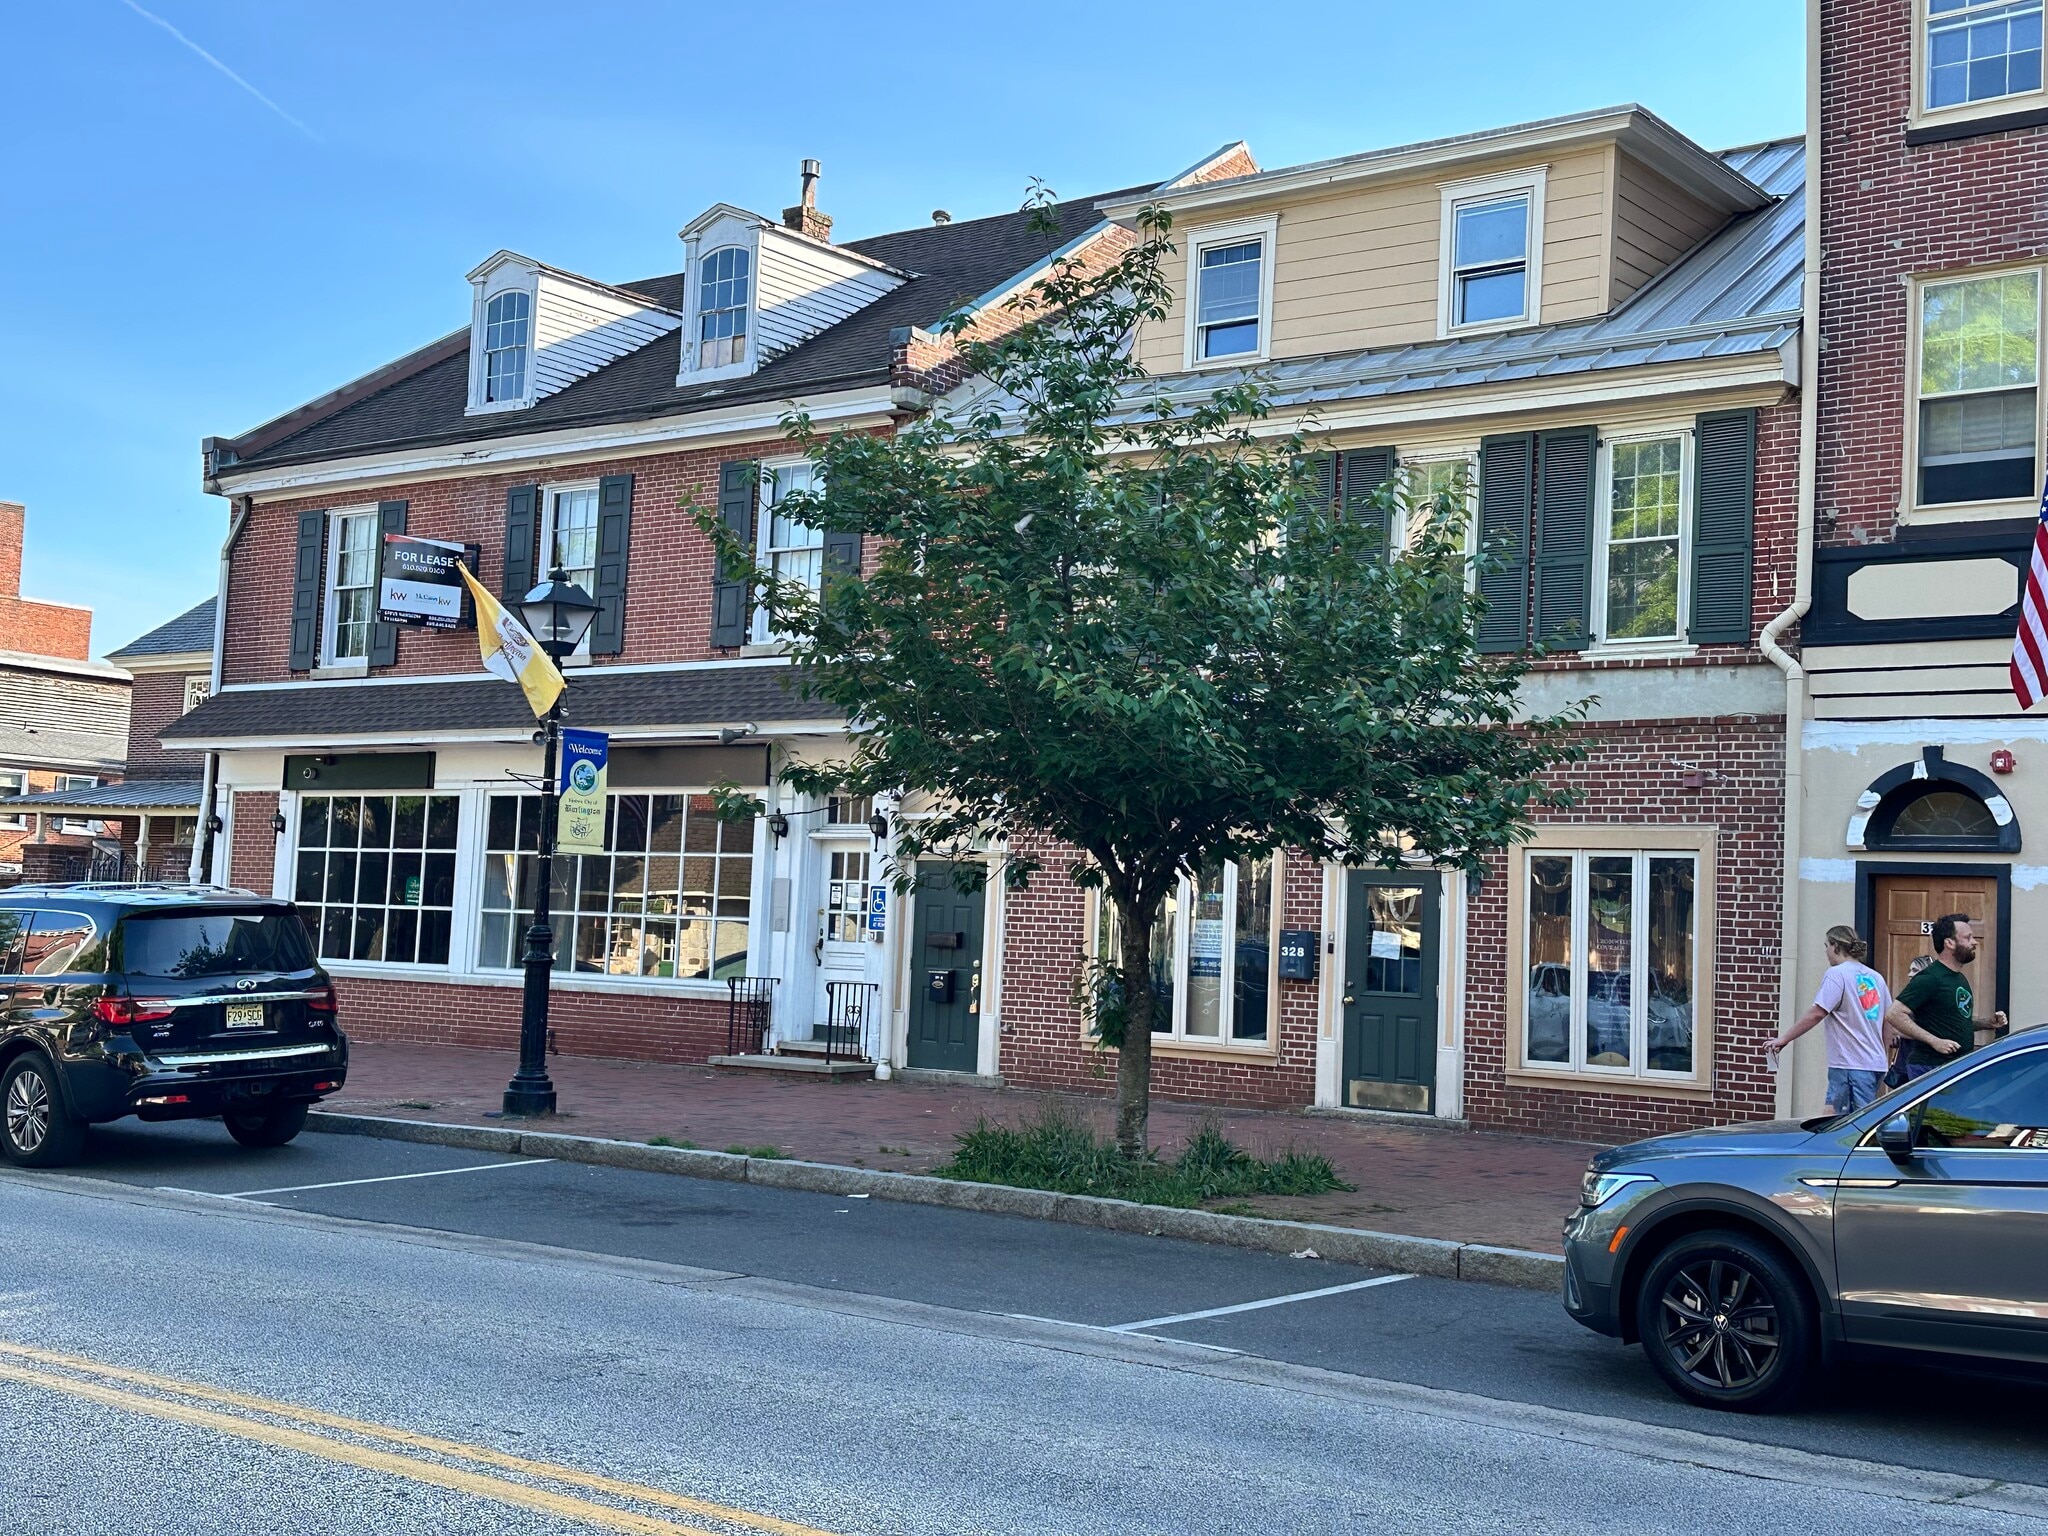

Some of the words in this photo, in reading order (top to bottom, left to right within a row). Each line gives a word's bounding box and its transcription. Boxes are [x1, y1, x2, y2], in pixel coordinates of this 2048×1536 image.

[394, 550, 418, 563] FOR
[420, 553, 454, 568] LEASE
[568, 743, 602, 756] Welcome
[564, 804, 601, 815] Burlington
[1281, 946, 1304, 957] 328
